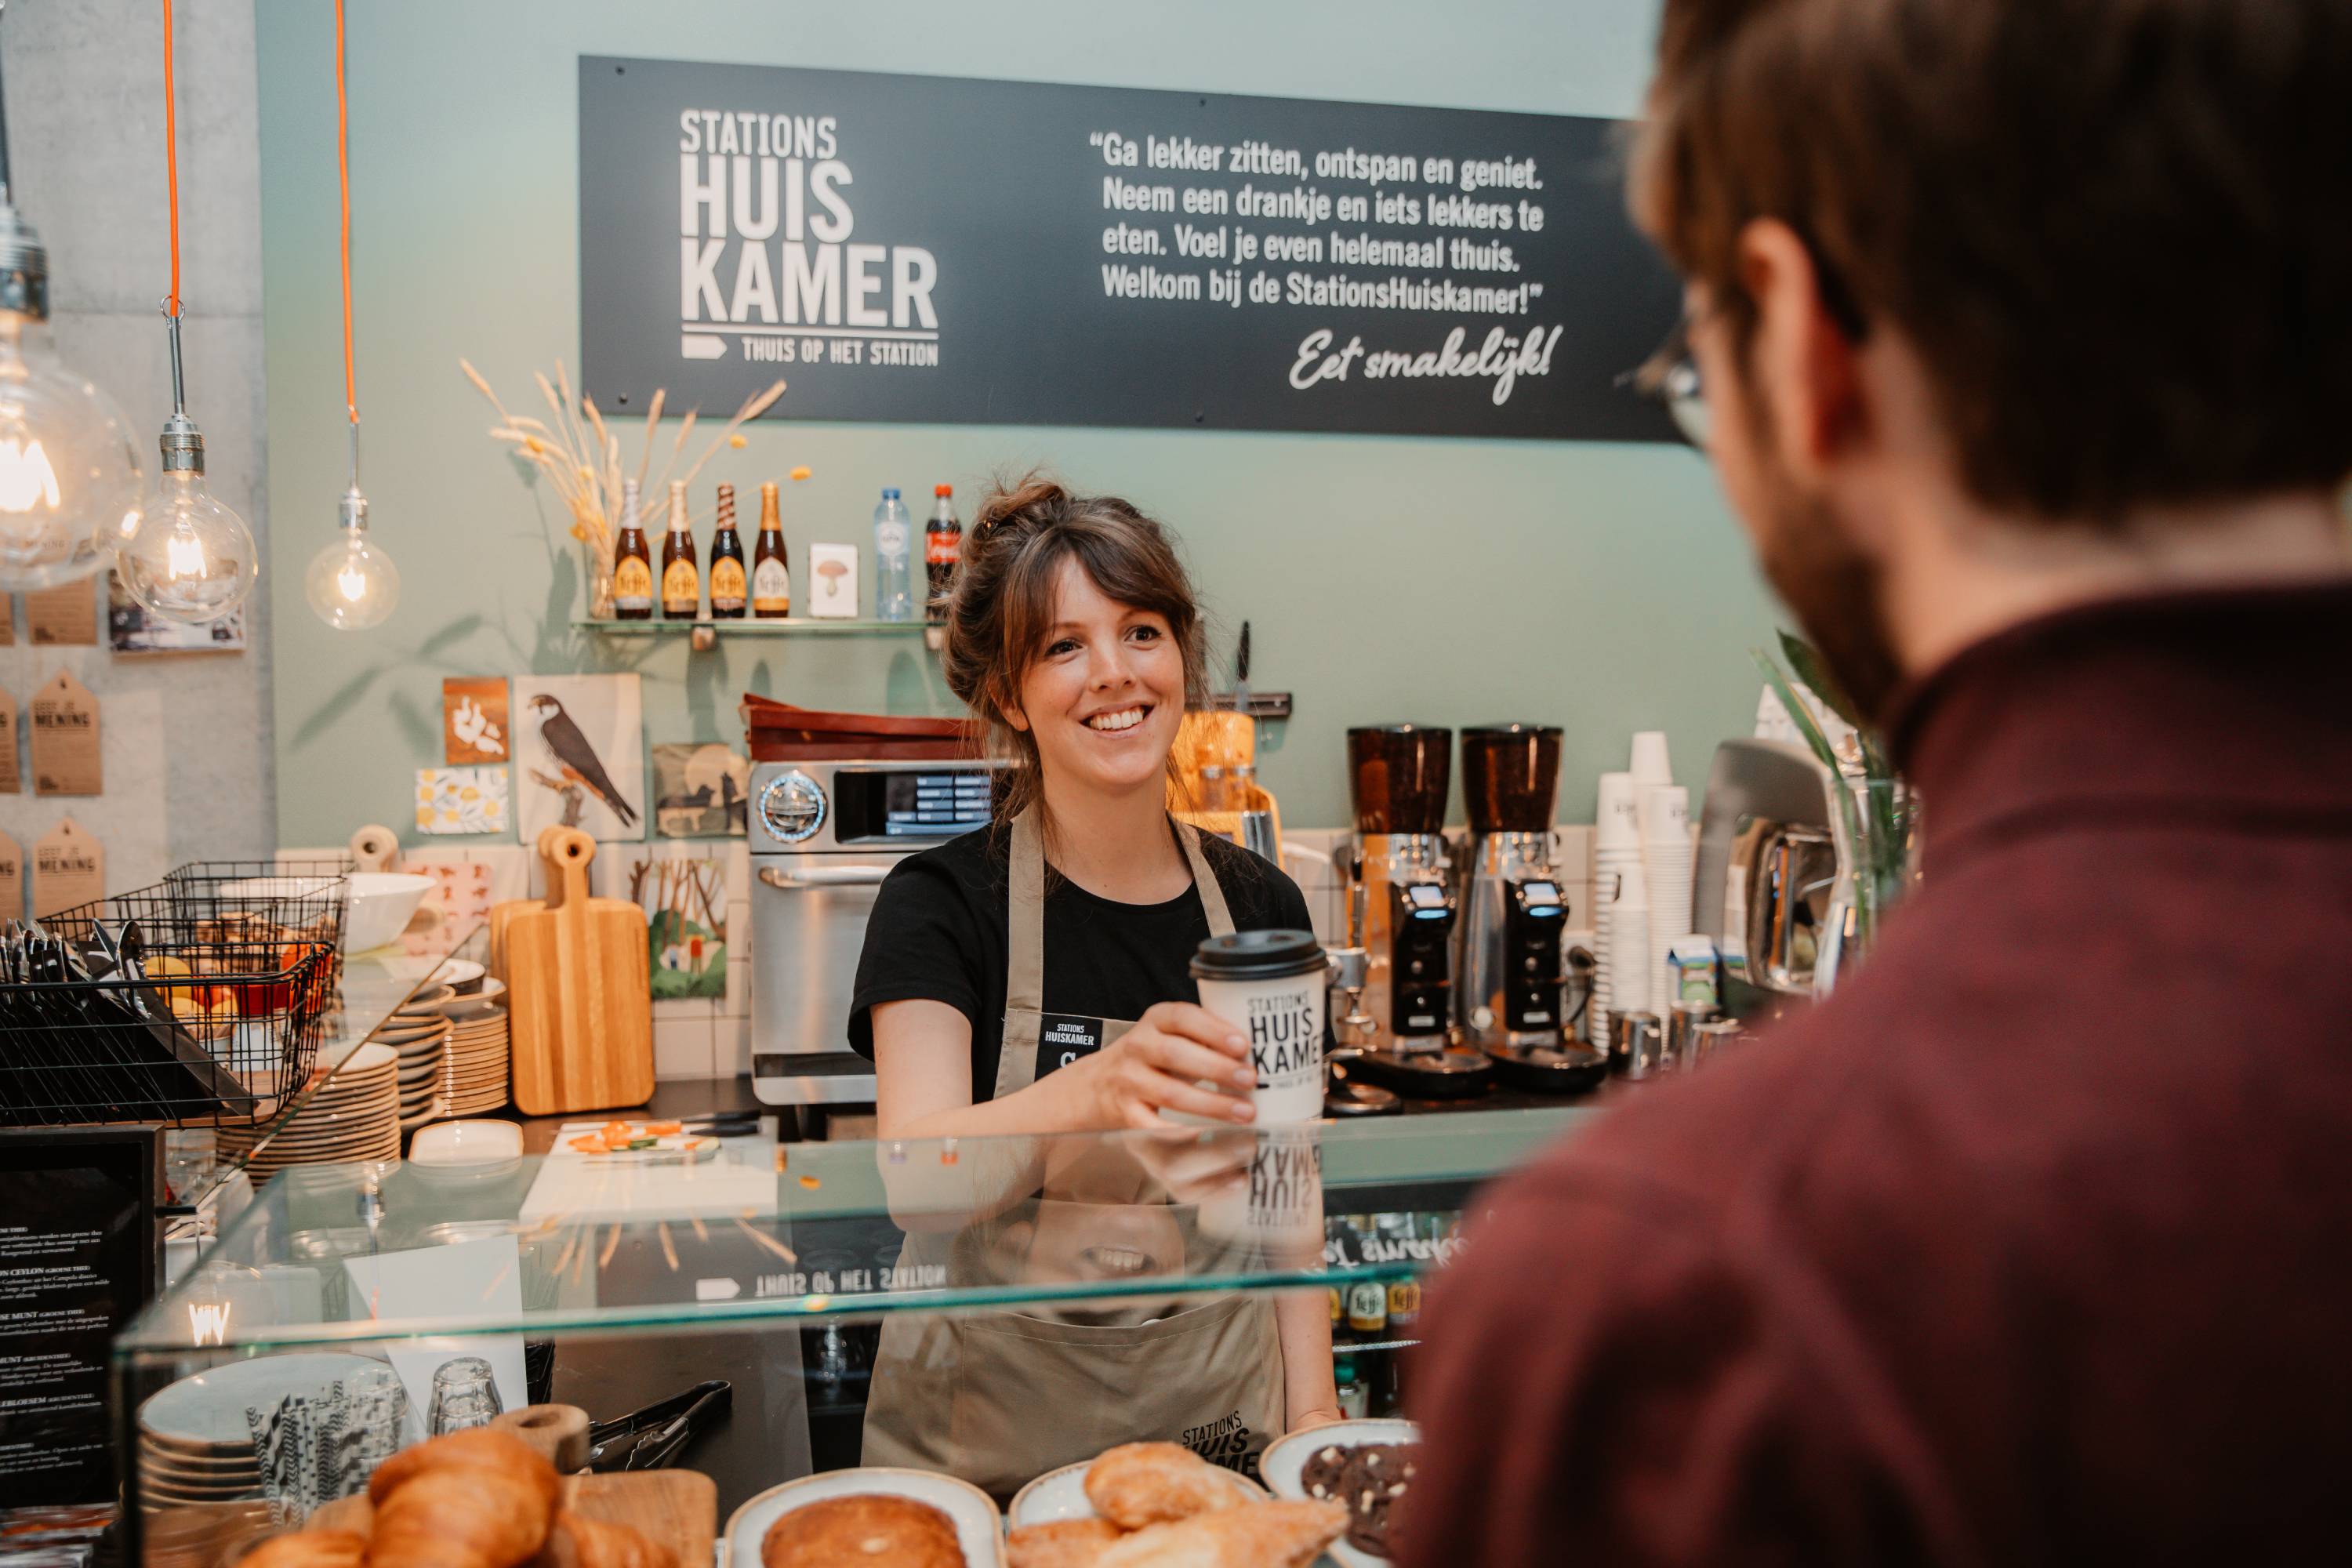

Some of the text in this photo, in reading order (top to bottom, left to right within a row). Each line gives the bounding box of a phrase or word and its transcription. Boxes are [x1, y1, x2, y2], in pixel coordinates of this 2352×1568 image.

[681, 109, 837, 159] STATIONS
[1148, 135, 1225, 171] lekker
[1229, 140, 1308, 181] zitten,
[1316, 147, 1417, 186] ontspan
[1423, 158, 1453, 184] en
[1461, 155, 1543, 191] geniet.
[681, 154, 854, 243] HUIS
[1103, 176, 1544, 231] Neem een drankje en iets lekkers te
[1103, 222, 1519, 272] eten. Voel je even helemaal thuis.
[681, 238, 938, 328] KAMER
[1102, 264, 1200, 300] Welkom
[1210, 269, 1241, 308] bij
[1249, 270, 1280, 303] de
[742, 336, 938, 366] THUIS OP HET STATION
[1289, 325, 1563, 406] Eet smakelijk!
[1045, 1031, 1094, 1045] HUISKAMER
[1057, 1023, 1084, 1033] STATIONS
[1249, 1007, 1313, 1044] HUIS
[1251, 1035, 1322, 1075] KAME
[10, 1267, 45, 1276] CEYLON
[12, 1311, 38, 1320] MUNT
[1182, 1410, 1243, 1446] STATIONS
